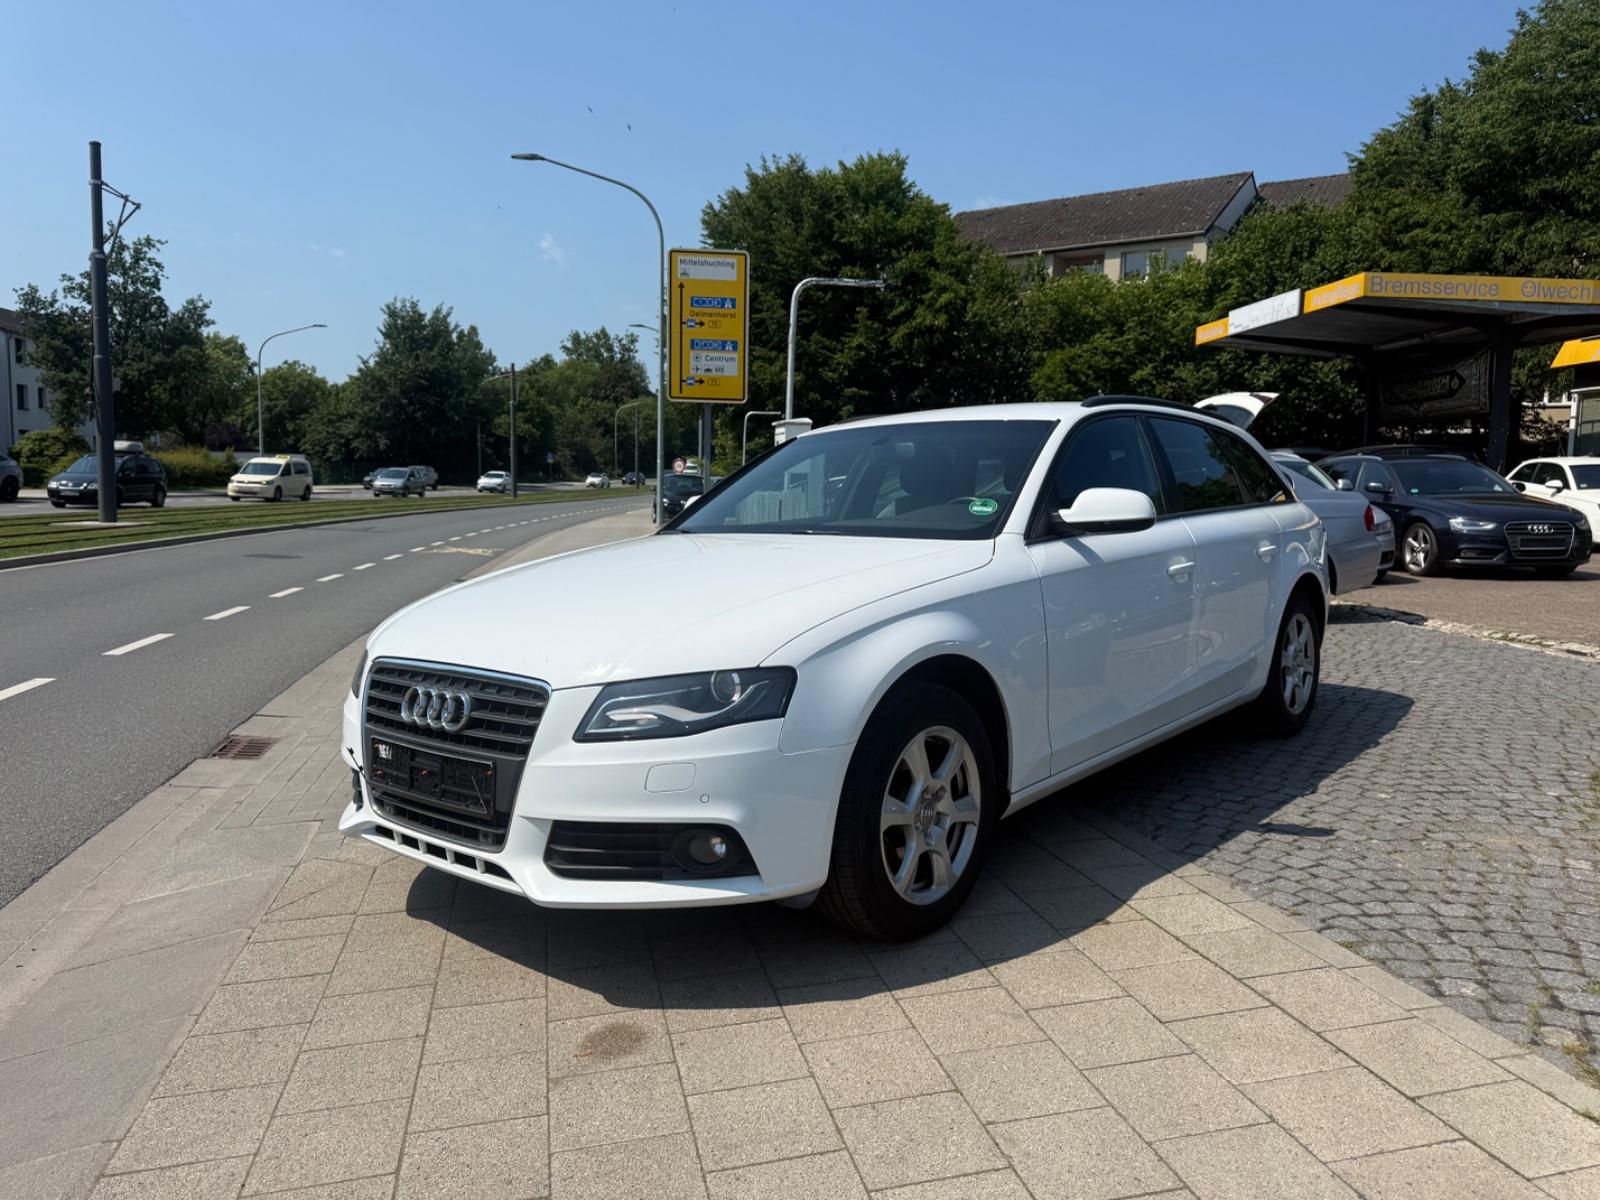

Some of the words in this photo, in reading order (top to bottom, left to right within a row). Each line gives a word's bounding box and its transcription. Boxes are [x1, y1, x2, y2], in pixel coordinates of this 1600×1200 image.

[679, 257, 736, 270] Mittelshuchting
[1370, 276, 1500, 298] Bremsservice
[690, 309, 736, 319] Delmenhorst
[704, 354, 736, 363] Centrum
